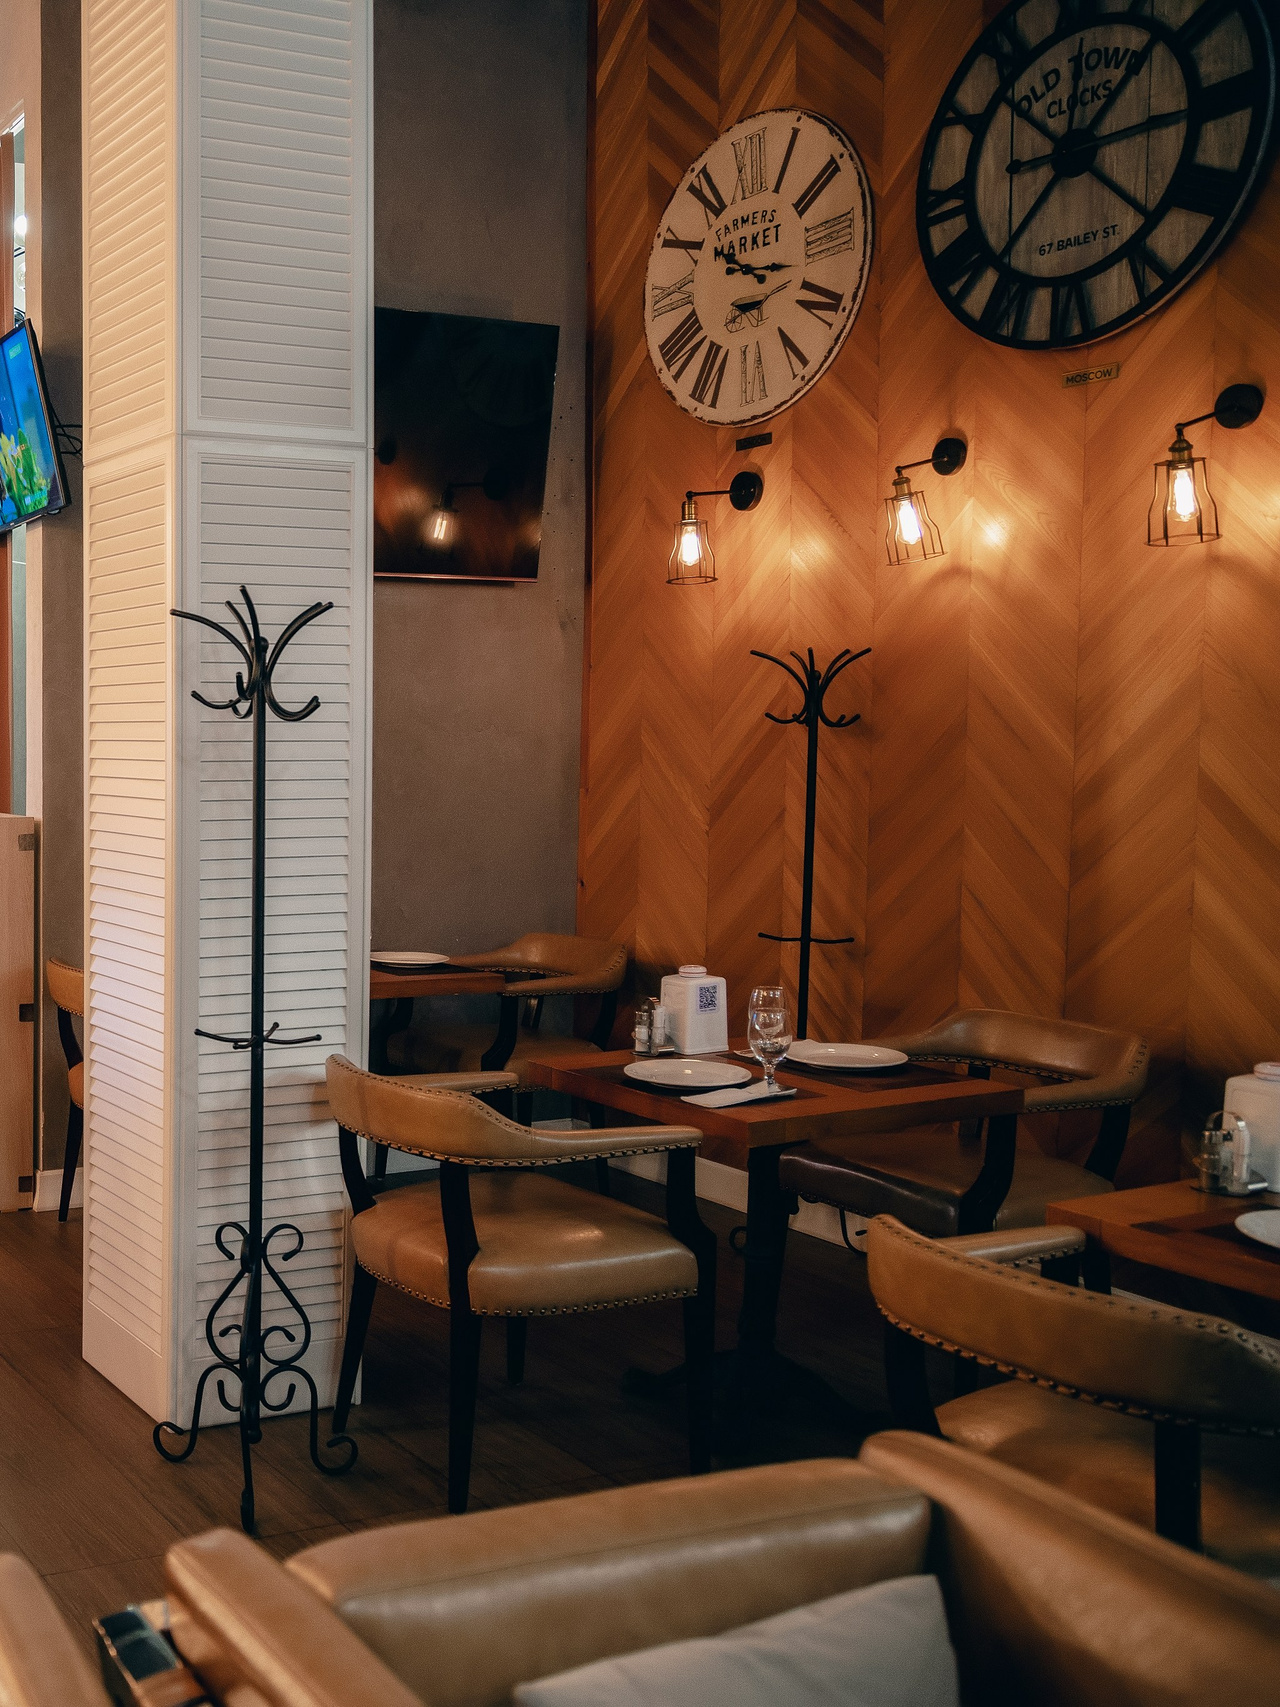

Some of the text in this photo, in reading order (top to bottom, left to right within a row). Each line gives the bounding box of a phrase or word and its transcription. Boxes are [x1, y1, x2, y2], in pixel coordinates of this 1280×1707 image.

[1014, 67, 1061, 118] OLD
[715, 208, 777, 242] FARMERS
[713, 223, 782, 262] MARKET
[1038, 241, 1053, 256] 67
[1056, 229, 1099, 252] BAILEY
[1065, 367, 1113, 385] MOSCOW
